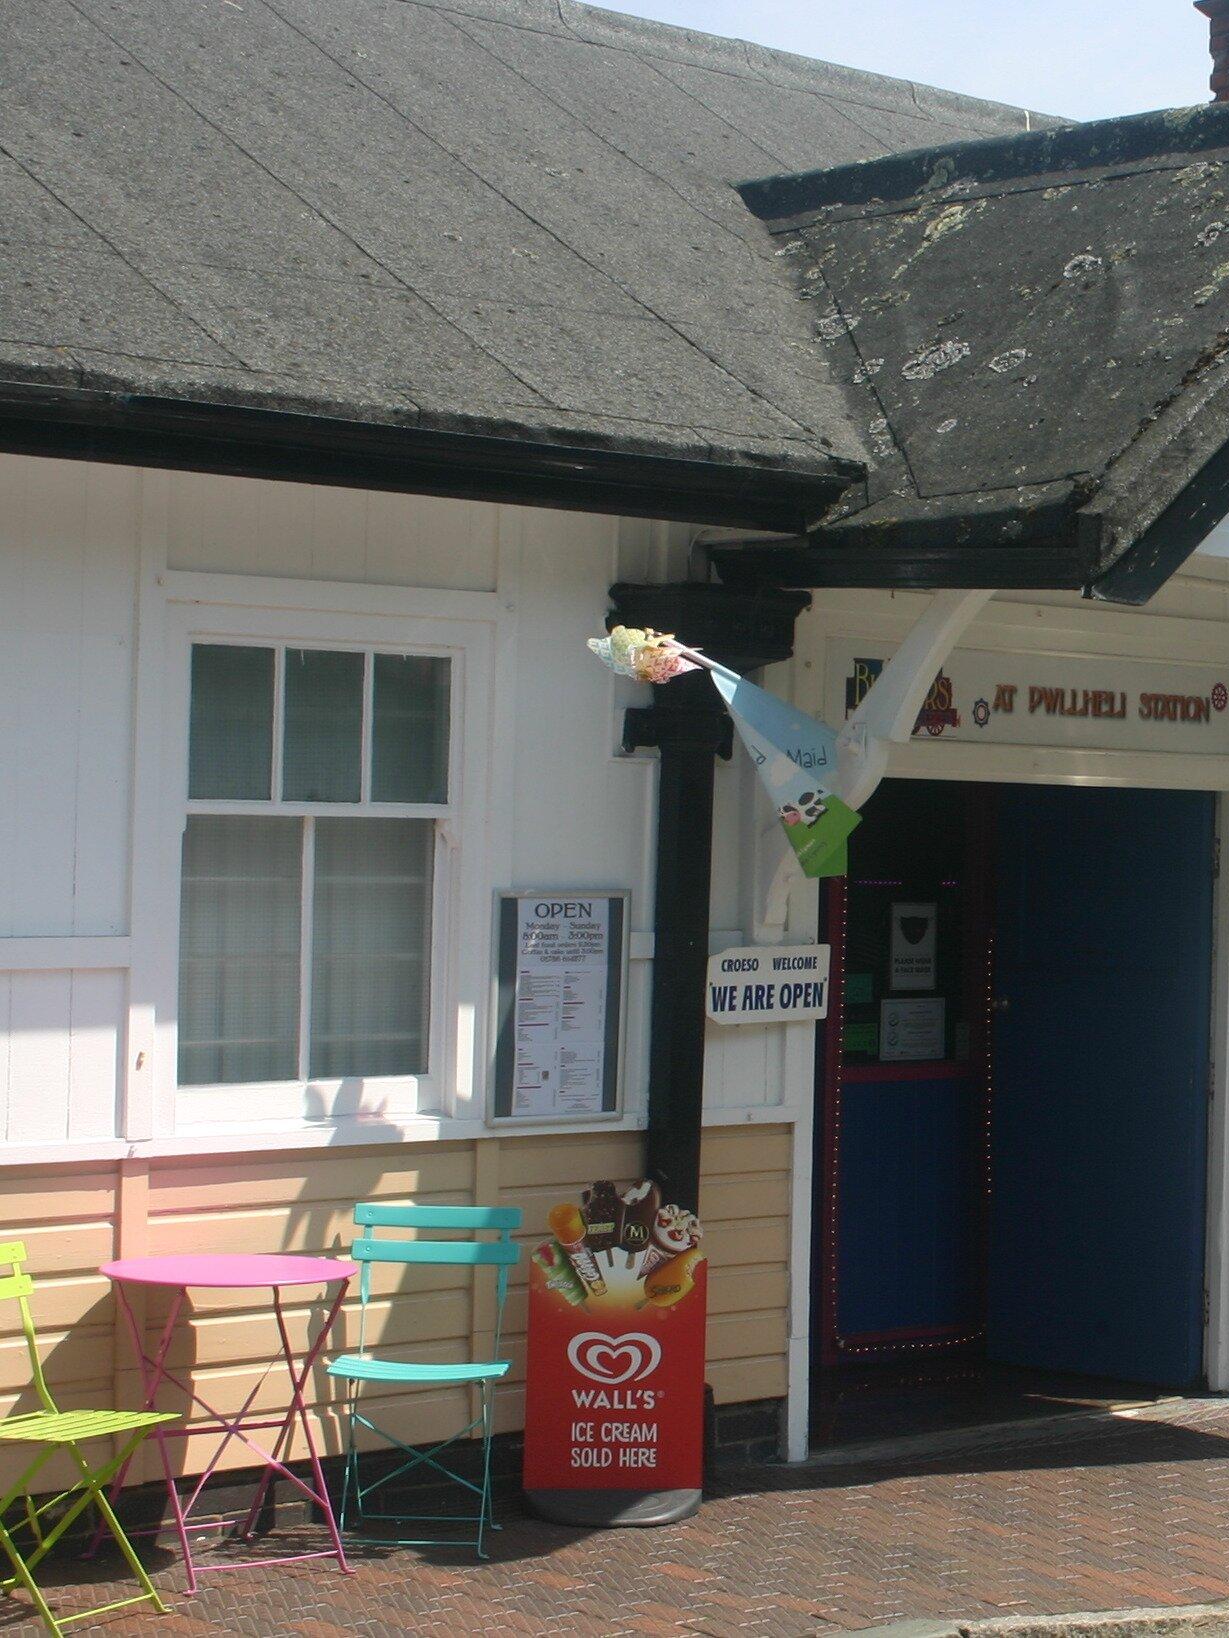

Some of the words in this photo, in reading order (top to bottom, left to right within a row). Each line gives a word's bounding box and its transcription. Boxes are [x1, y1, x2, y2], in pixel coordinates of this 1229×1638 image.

[992, 684, 1017, 713] AT
[1027, 686, 1127, 719] PWLLHELI
[1138, 692, 1211, 724] STATION
[787, 745, 827, 768] Maid
[534, 902, 592, 919] OPEN
[721, 958, 759, 973] CROESO
[773, 956, 818, 971] WELCOME
[711, 985, 738, 1013] WE
[741, 984, 776, 1011] ARE
[779, 982, 824, 1009] OPEN
[629, 1225, 644, 1238] M
[571, 1389, 656, 1410] WALL'S
[571, 1422, 594, 1442] ICE
[601, 1422, 658, 1443] CREAM
[570, 1447, 613, 1468] SOLD
[619, 1448, 657, 1468] HERE
